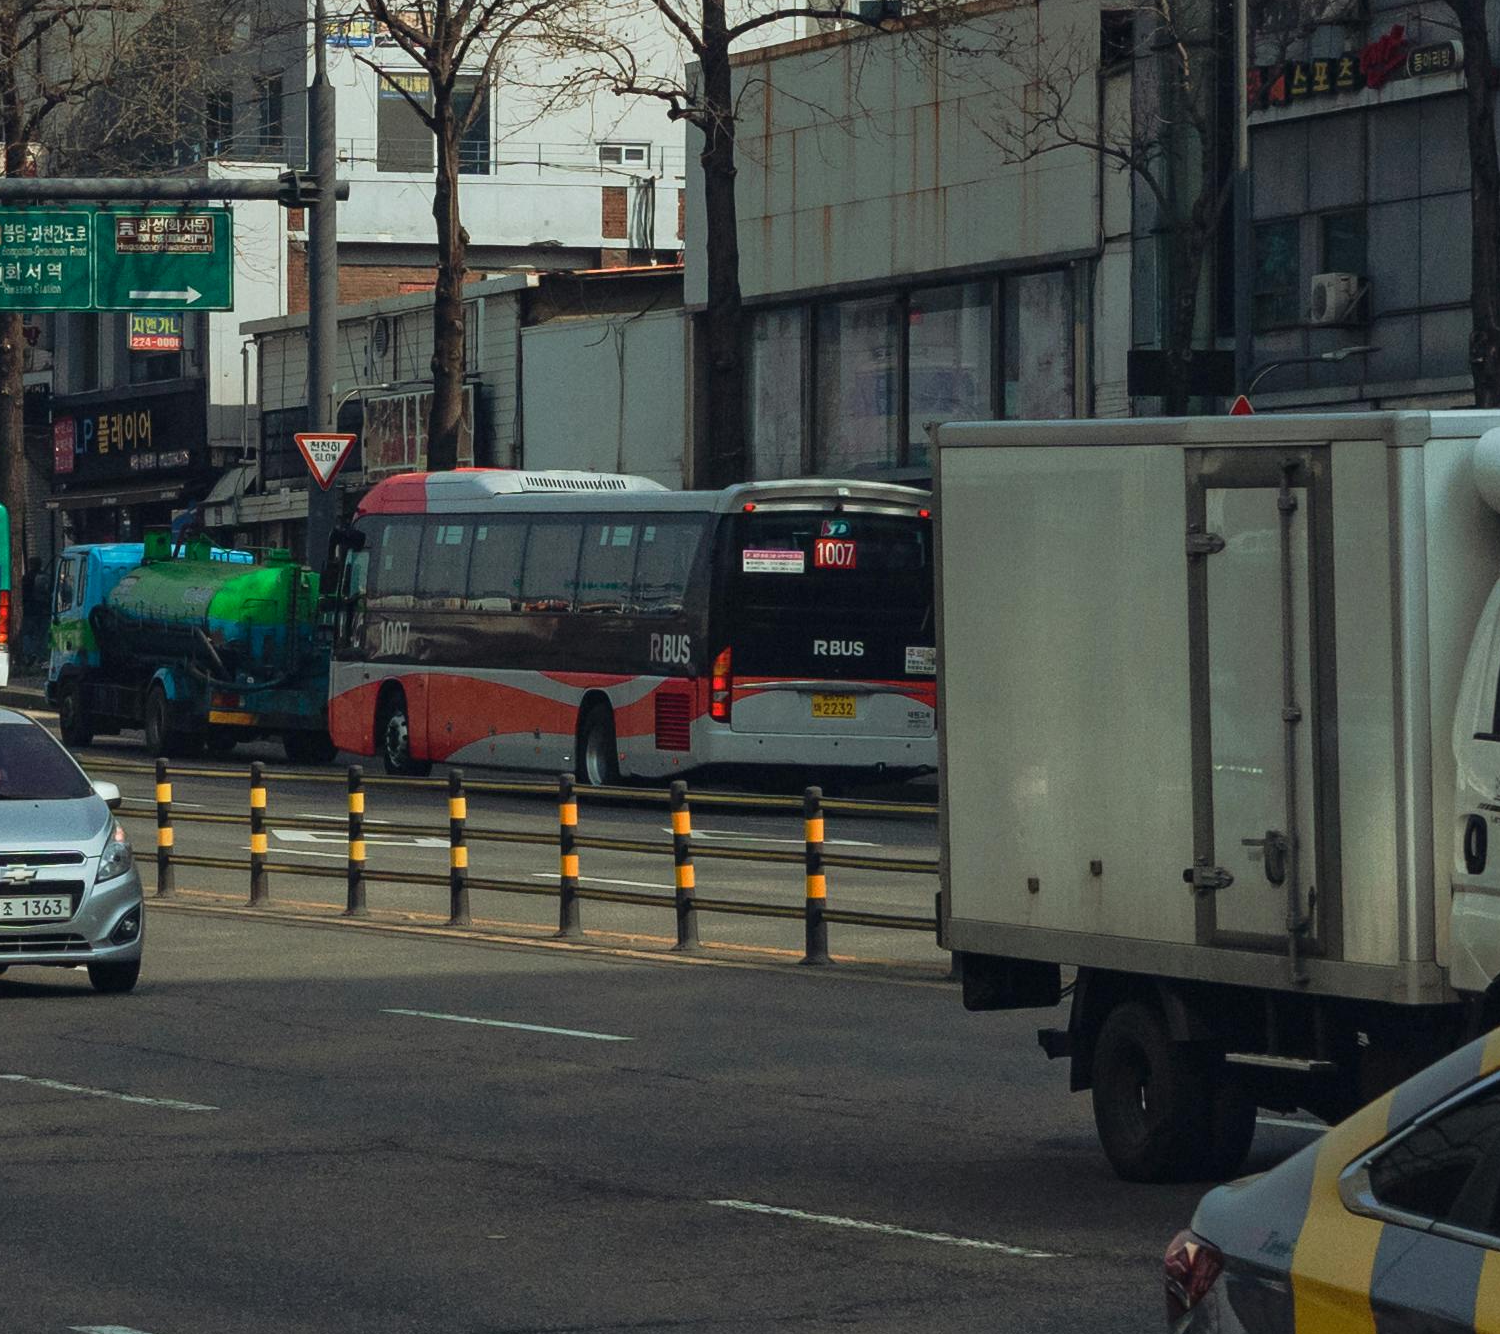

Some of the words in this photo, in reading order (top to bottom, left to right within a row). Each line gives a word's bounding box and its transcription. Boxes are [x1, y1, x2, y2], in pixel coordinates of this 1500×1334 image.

[5, 261, 62, 281] 화서역
[310, 441, 340, 452] 천천히
[314, 452, 337, 462] SLOW
[817, 542, 854, 566] 1007
[379, 620, 411, 655] 1007
[823, 702, 853, 715] 2232
[22, 899, 62, 916] 1363
